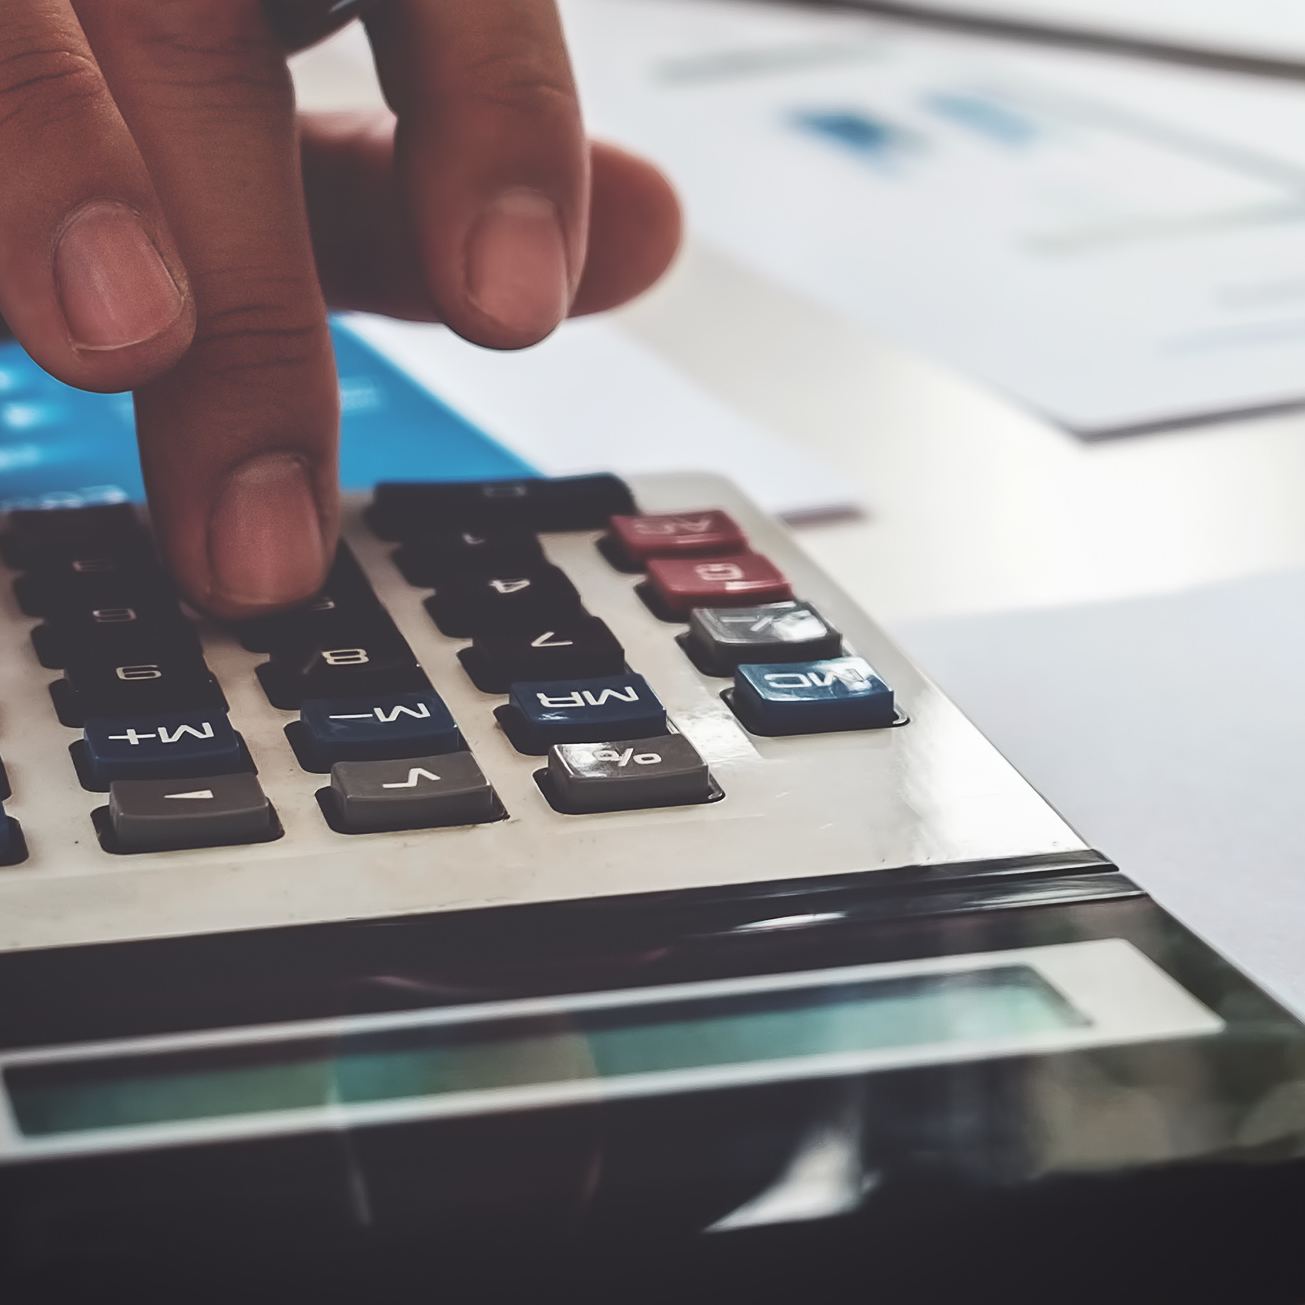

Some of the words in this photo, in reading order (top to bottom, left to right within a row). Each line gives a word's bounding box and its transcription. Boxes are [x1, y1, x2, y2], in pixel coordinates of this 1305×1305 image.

[487, 577, 532, 595] 4
[91, 606, 138, 624] 6
[530, 630, 575, 649] 7
[321, 647, 371, 667] 8
[115, 663, 163, 682] 9
[762, 667, 867, 691] MC
[535, 684, 640, 710] MR
[107, 720, 215, 745] M+
[591, 746, 663, 769] %
